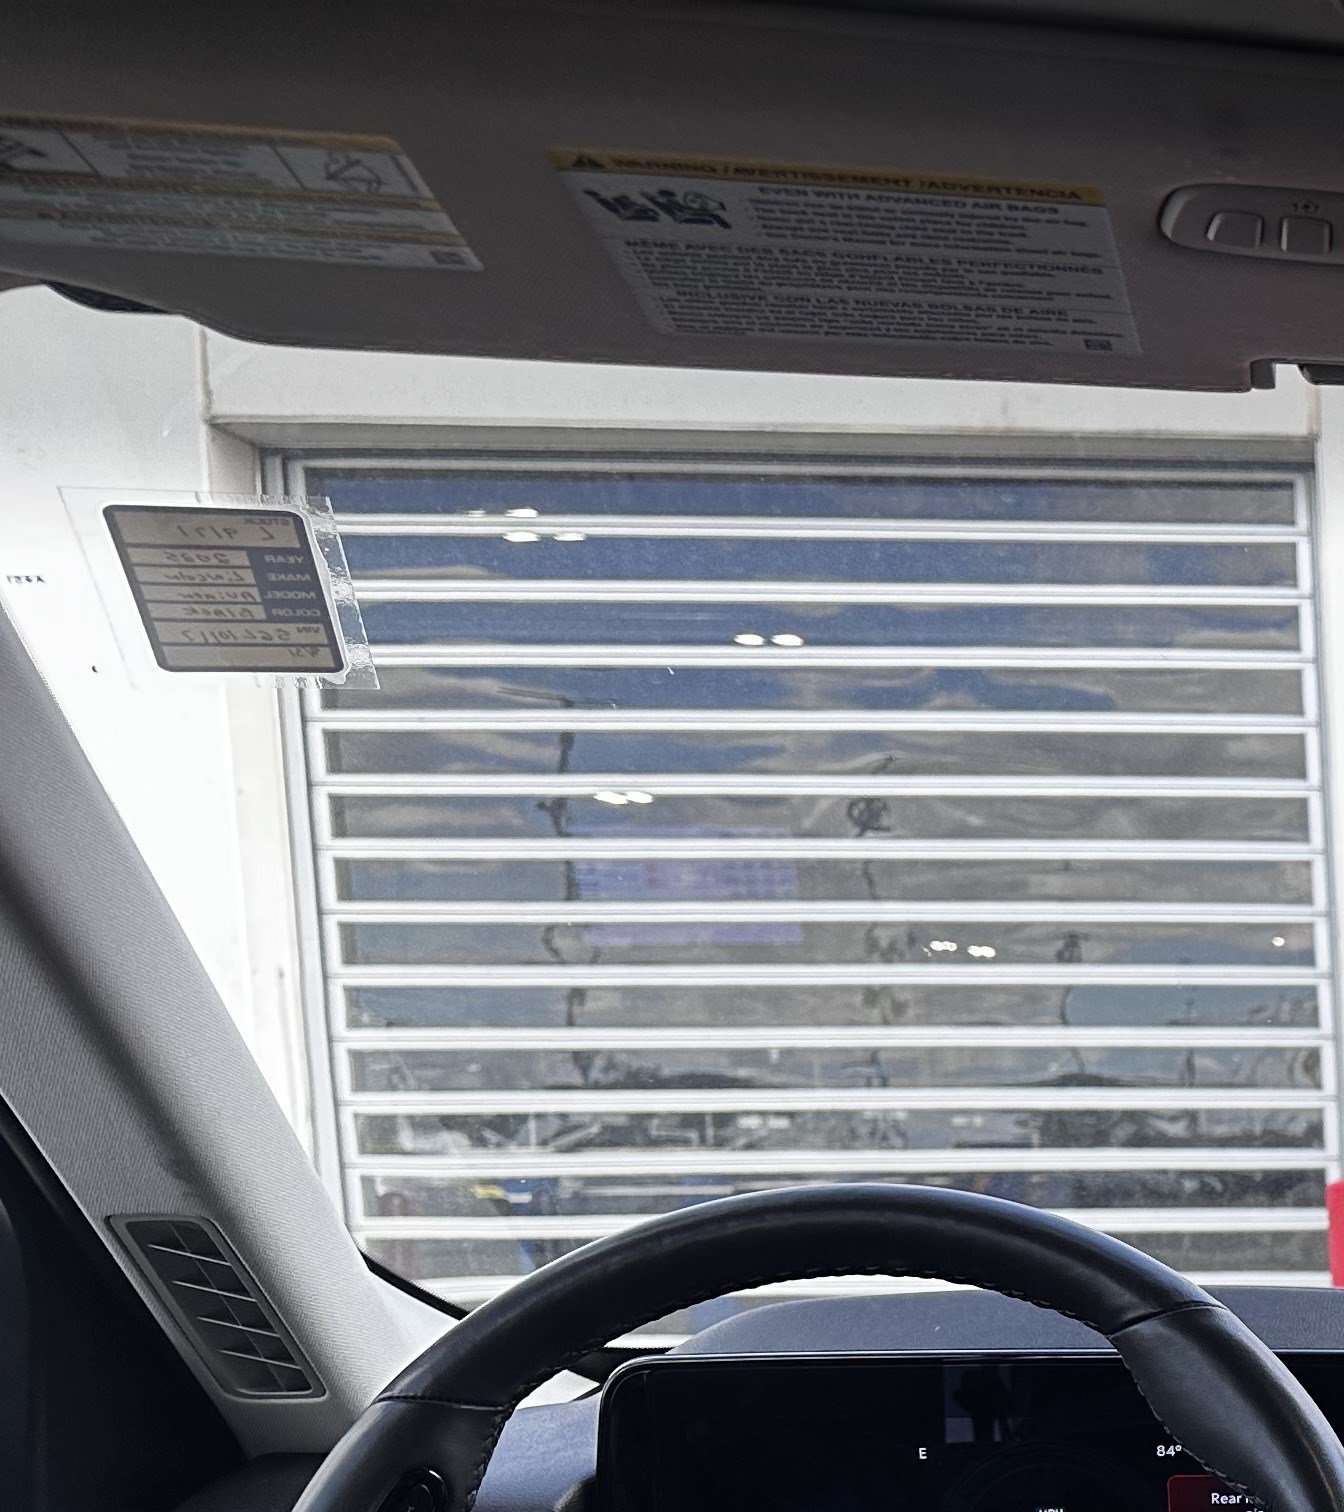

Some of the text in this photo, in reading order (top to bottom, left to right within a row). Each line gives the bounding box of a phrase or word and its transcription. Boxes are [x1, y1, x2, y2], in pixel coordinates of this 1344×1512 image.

[918, 1447, 928, 1459] E
[1155, 1444, 1182, 1457] 84°
[1210, 1492, 1243, 1505] Rear
